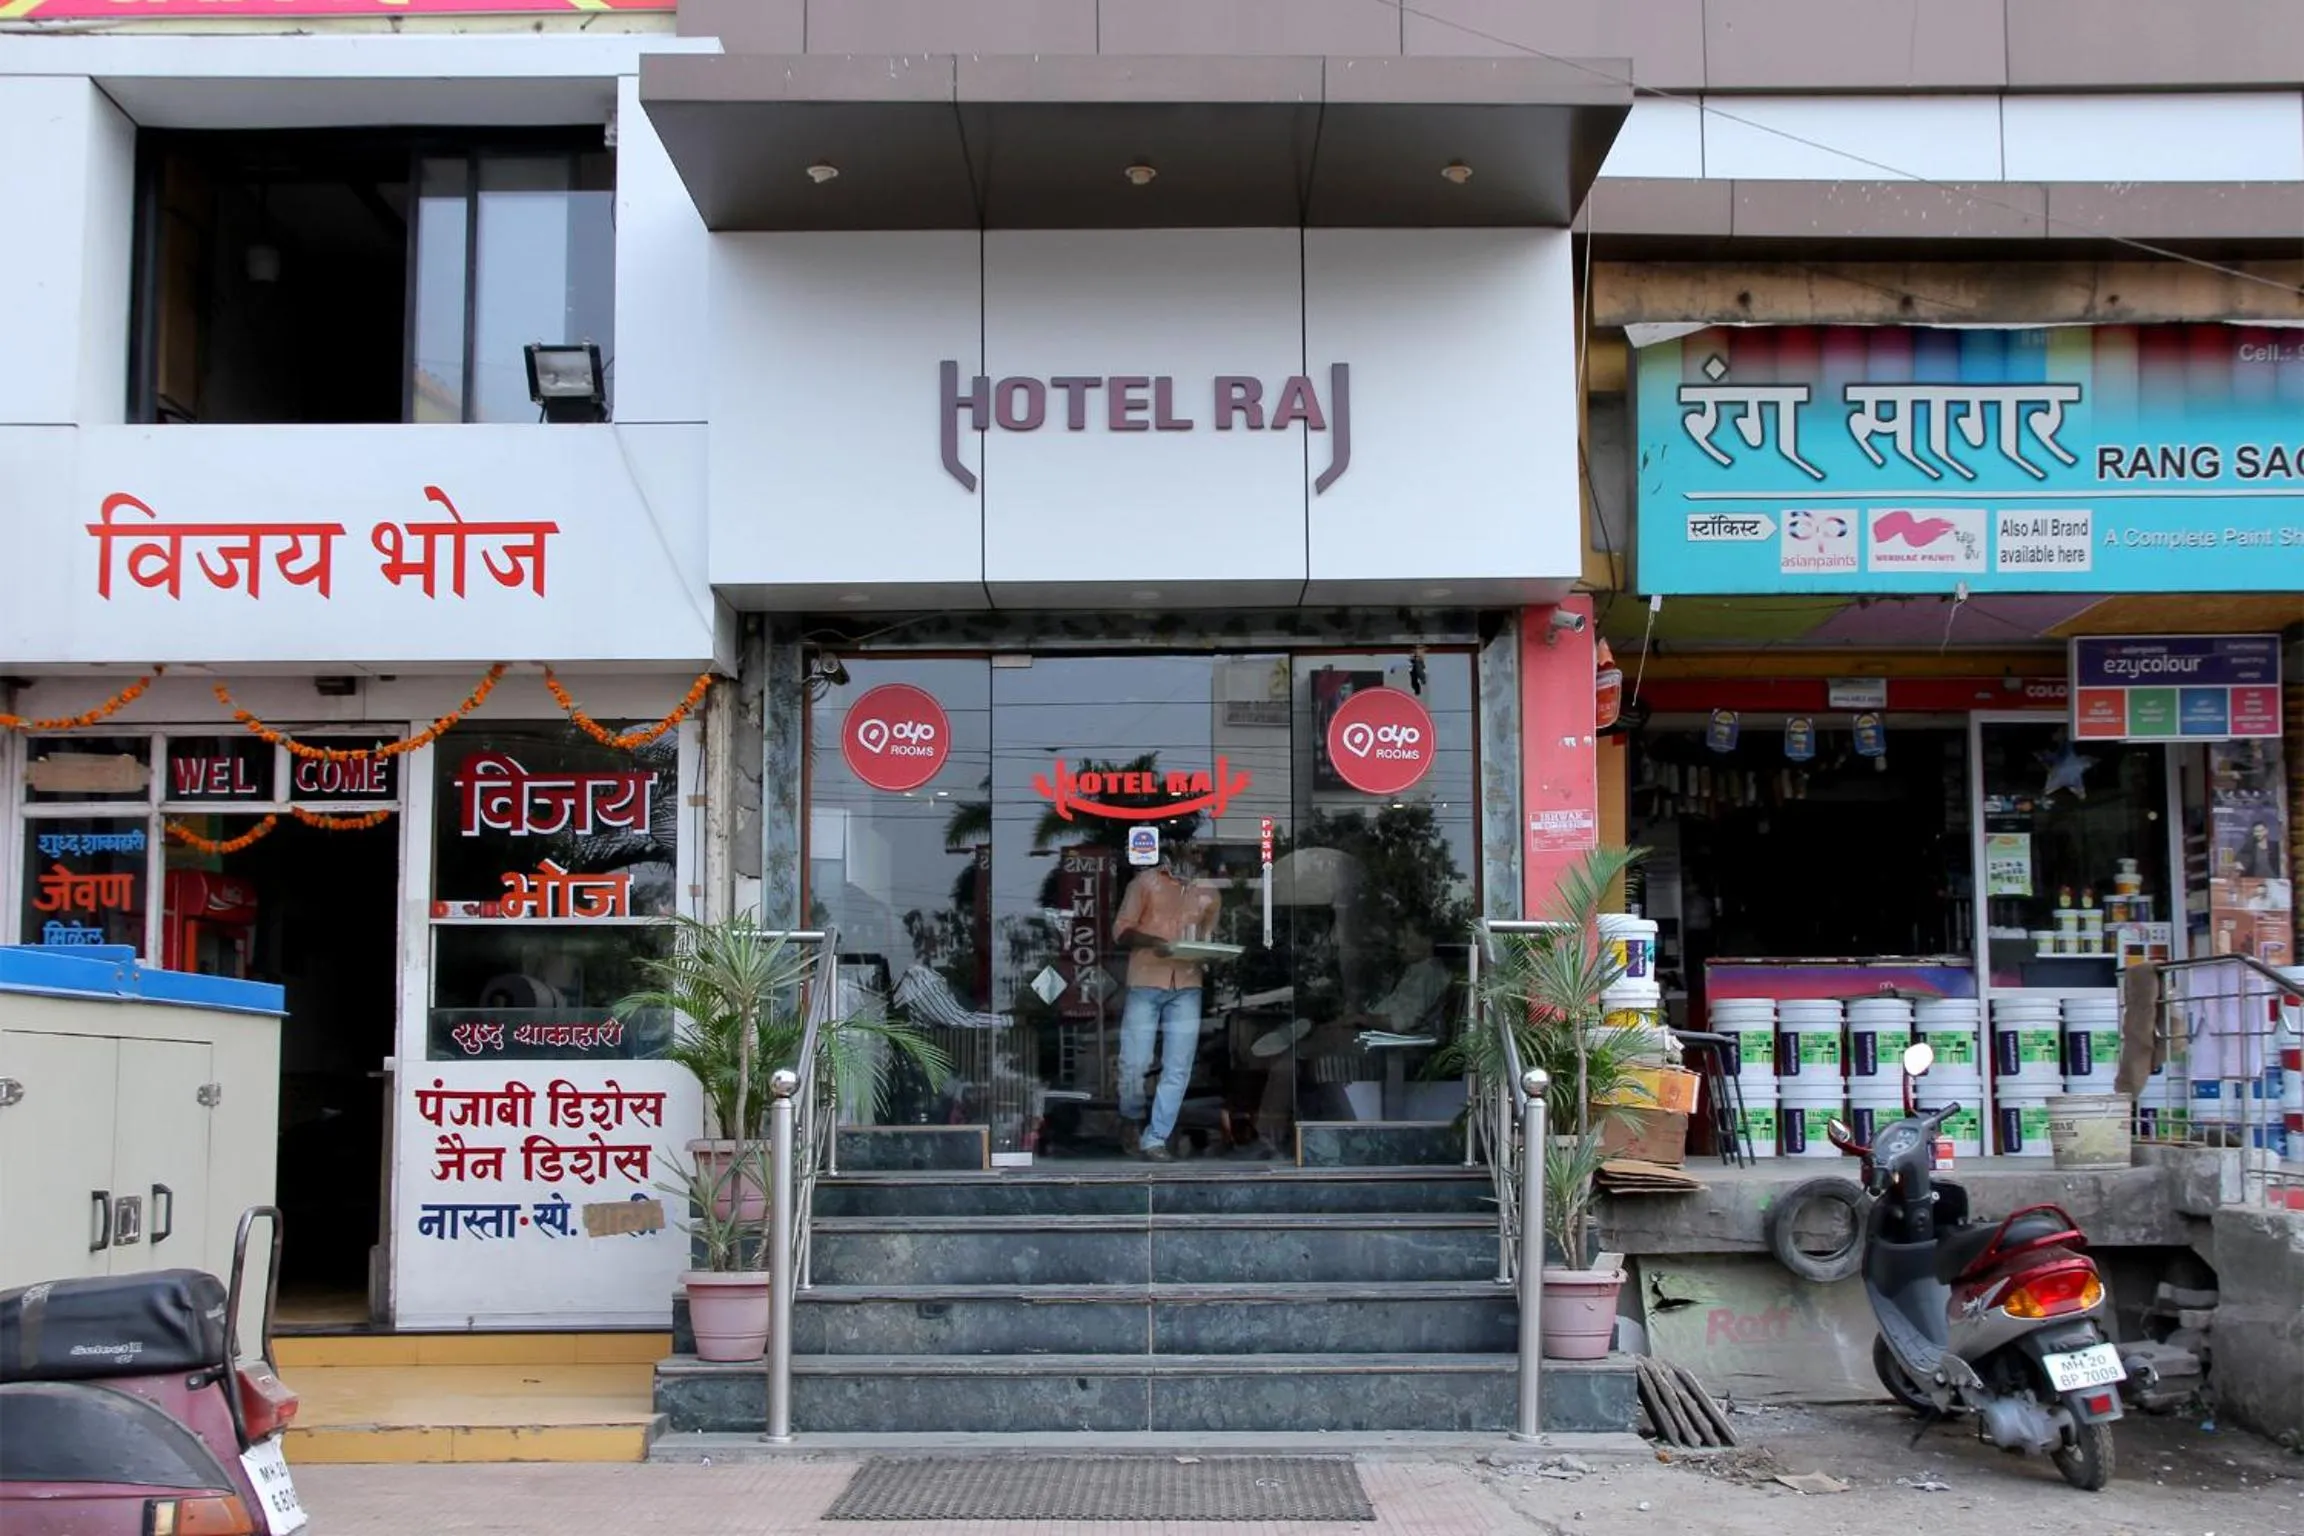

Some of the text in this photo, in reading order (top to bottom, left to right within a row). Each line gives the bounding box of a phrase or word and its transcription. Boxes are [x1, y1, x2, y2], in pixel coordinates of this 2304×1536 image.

[940, 360, 1351, 495] HOTEL RAJ
[1678, 354, 2083, 482] रंग सागर
[2097, 444, 2222, 481] RANG
[86, 486, 561, 600] विजय भोज
[1689, 515, 1761, 537] स्टॉकिस्ट
[2000, 517, 2089, 537] Also All Brand
[2103, 528, 2120, 547] A
[2123, 526, 2218, 550] Complete
[2222, 526, 2274, 547] Paint
[1781, 554, 1857, 569] asianpaints
[2000, 545, 2054, 564] available
[2057, 545, 2086, 563] here
[2103, 655, 2202, 678] ezycolour
[890, 745, 935, 757] ROOMS
[1375, 748, 1421, 760] ROOMS
[172, 756, 389, 795] WEL COME
[454, 750, 658, 836] विजय
[1261, 818, 1272, 860] PUSH
[33, 863, 136, 912] जेवण
[500, 857, 635, 919] भोज
[415, 1078, 667, 1131] पंजाबी डिशेस
[431, 1132, 652, 1185] जैन डिशेस
[418, 1203, 522, 1241] नास्ता
[2087, 1354, 2107, 1368] 20
